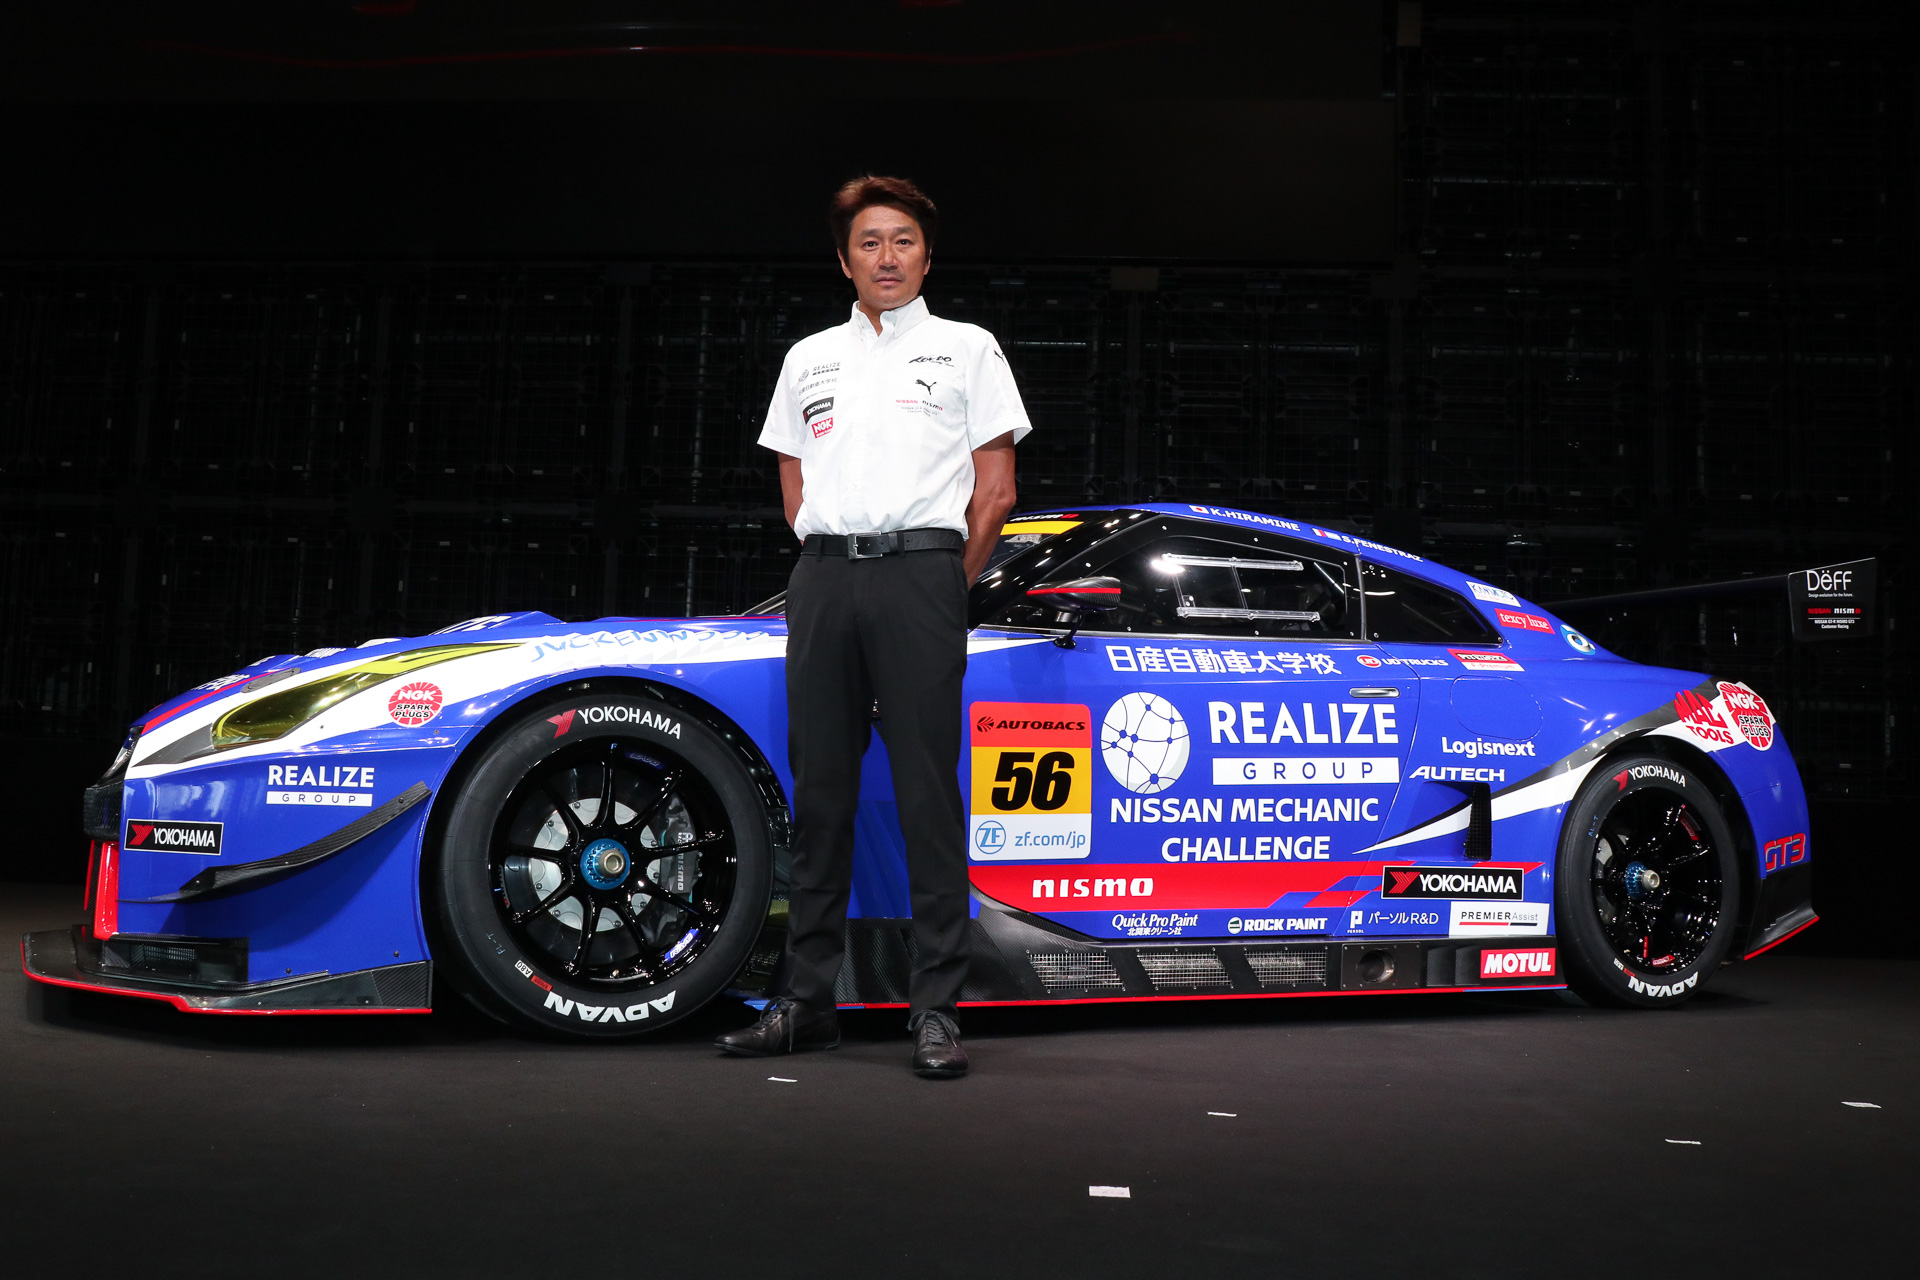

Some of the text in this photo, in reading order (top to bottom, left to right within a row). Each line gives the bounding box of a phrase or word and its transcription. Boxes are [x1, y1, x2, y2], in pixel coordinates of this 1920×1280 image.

[813, 418, 833, 433] NGK
[1209, 507, 1301, 531] K.HIRAMINE
[1499, 612, 1527, 628] texcy
[1105, 645, 1343, 675] 日産自動車大学校
[1381, 658, 1400, 666] UD
[397, 689, 437, 701] NGK
[1726, 692, 1760, 710] NGK
[578, 706, 682, 740] YOKOHAMA
[996, 720, 1086, 732] AUTOBACS
[1208, 701, 1400, 744] REALIZE
[1738, 715, 1765, 725] SPARK
[1684, 725, 1734, 745] TOOLS
[1743, 726, 1770, 737] PLUGS
[1441, 737, 1536, 758] Logisnext
[267, 765, 375, 788] REALIZE
[991, 751, 1075, 811] 56
[1242, 762, 1374, 780] GROUP
[1408, 765, 1505, 782] AUTECH
[1627, 765, 1686, 788] YOKOHAMA
[282, 793, 356, 804] GROUP
[1110, 798, 1379, 823] NISSAN MECHANIC
[153, 826, 216, 848] YOKOHAMA
[977, 828, 1003, 847] ZF
[1015, 831, 1086, 849] zf.com/jp
[1161, 836, 1331, 862] CHALLENGE
[1763, 832, 1807, 871] GT3
[1032, 877, 1154, 898] nismo
[1418, 873, 1517, 894] YOKOHAMA
[1112, 912, 1198, 931] Quick Pro Paint
[1244, 918, 1328, 931] ROCK PAINT
[1484, 952, 1552, 974] MOTUL
[1628, 971, 1699, 998] ADVAN
[543, 990, 677, 1023] ADVAN
